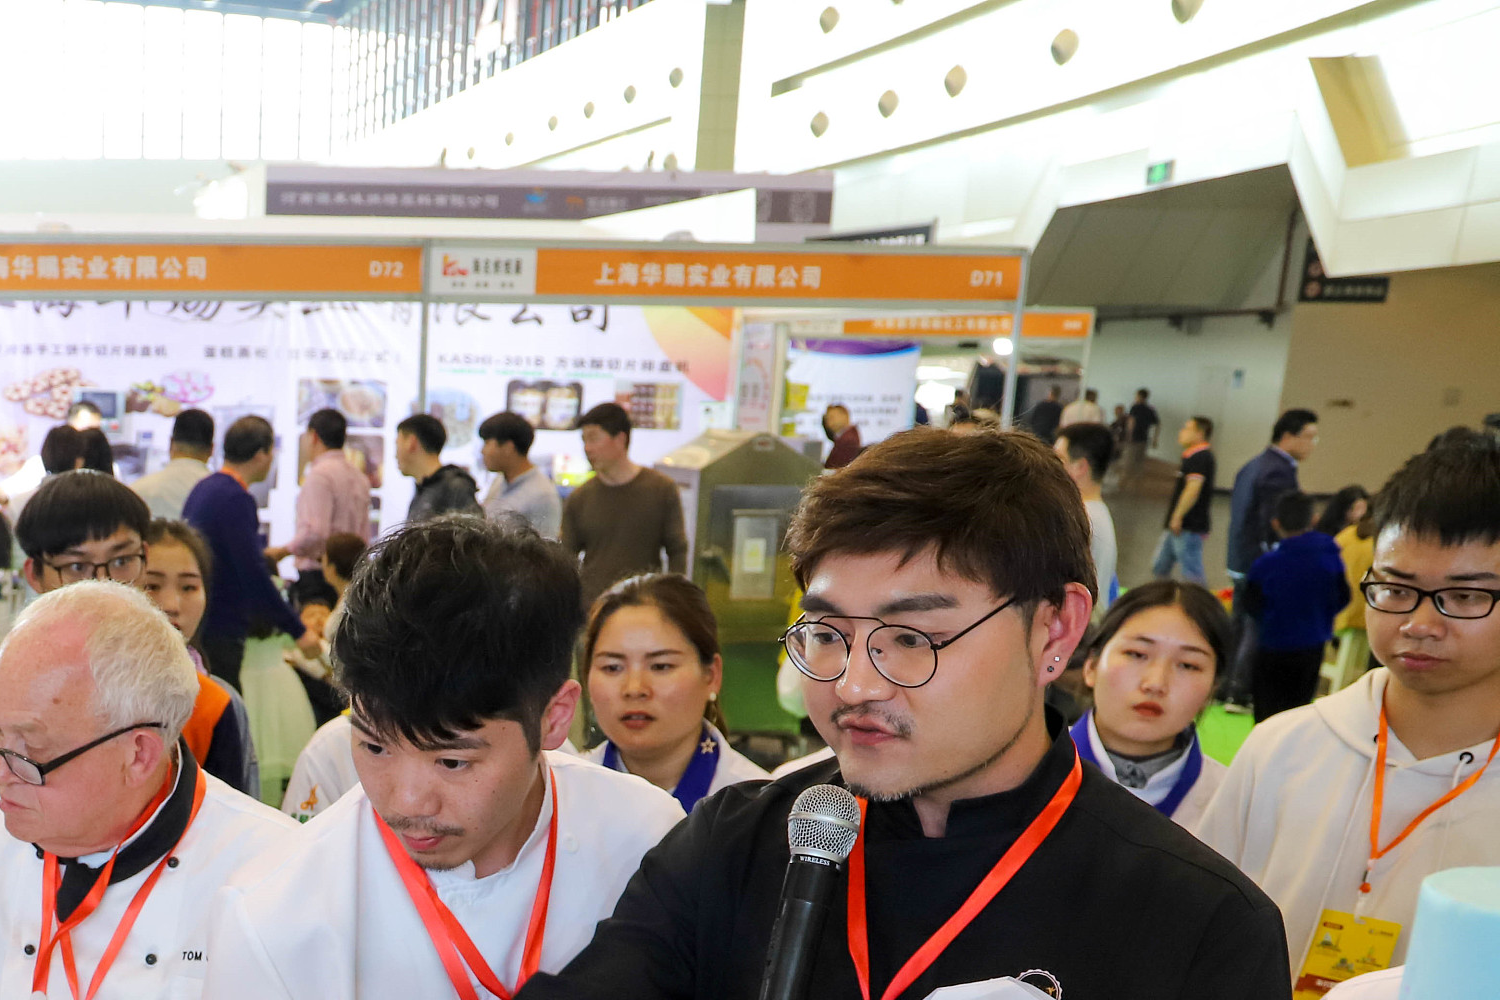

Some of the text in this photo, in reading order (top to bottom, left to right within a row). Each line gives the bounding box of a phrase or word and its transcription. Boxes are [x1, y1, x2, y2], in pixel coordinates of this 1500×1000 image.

[369, 260, 403, 278] D72
[970, 269, 1002, 286] D71
[182, 950, 203, 961] TOM
